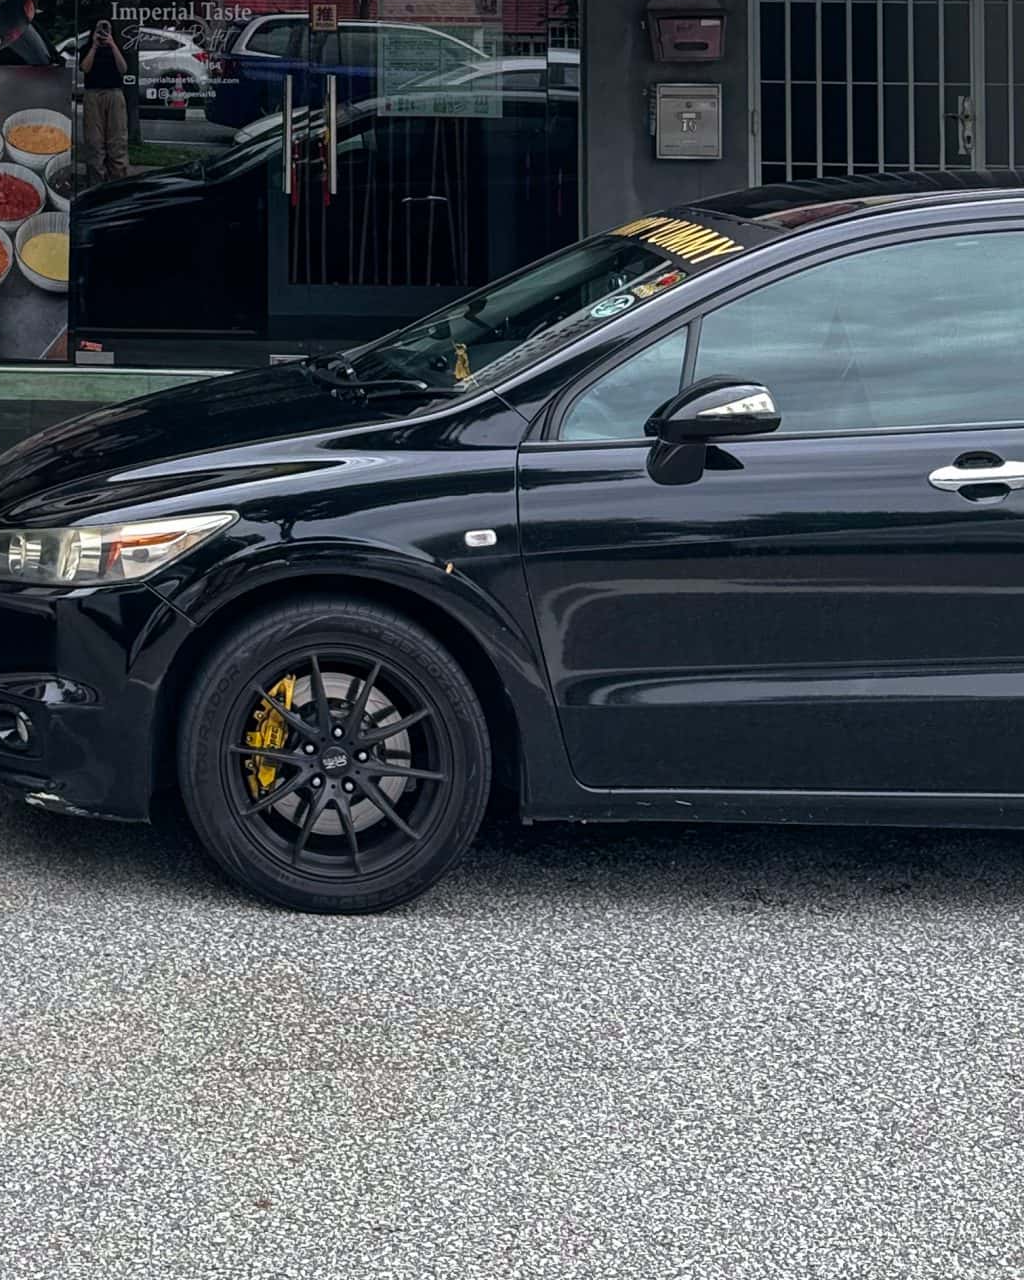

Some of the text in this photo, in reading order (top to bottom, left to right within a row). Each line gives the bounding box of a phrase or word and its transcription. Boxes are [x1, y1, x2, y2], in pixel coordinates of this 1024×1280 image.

[111, 2, 252, 26] Imperial Taste
[639, 218, 745, 265] YUMMY
